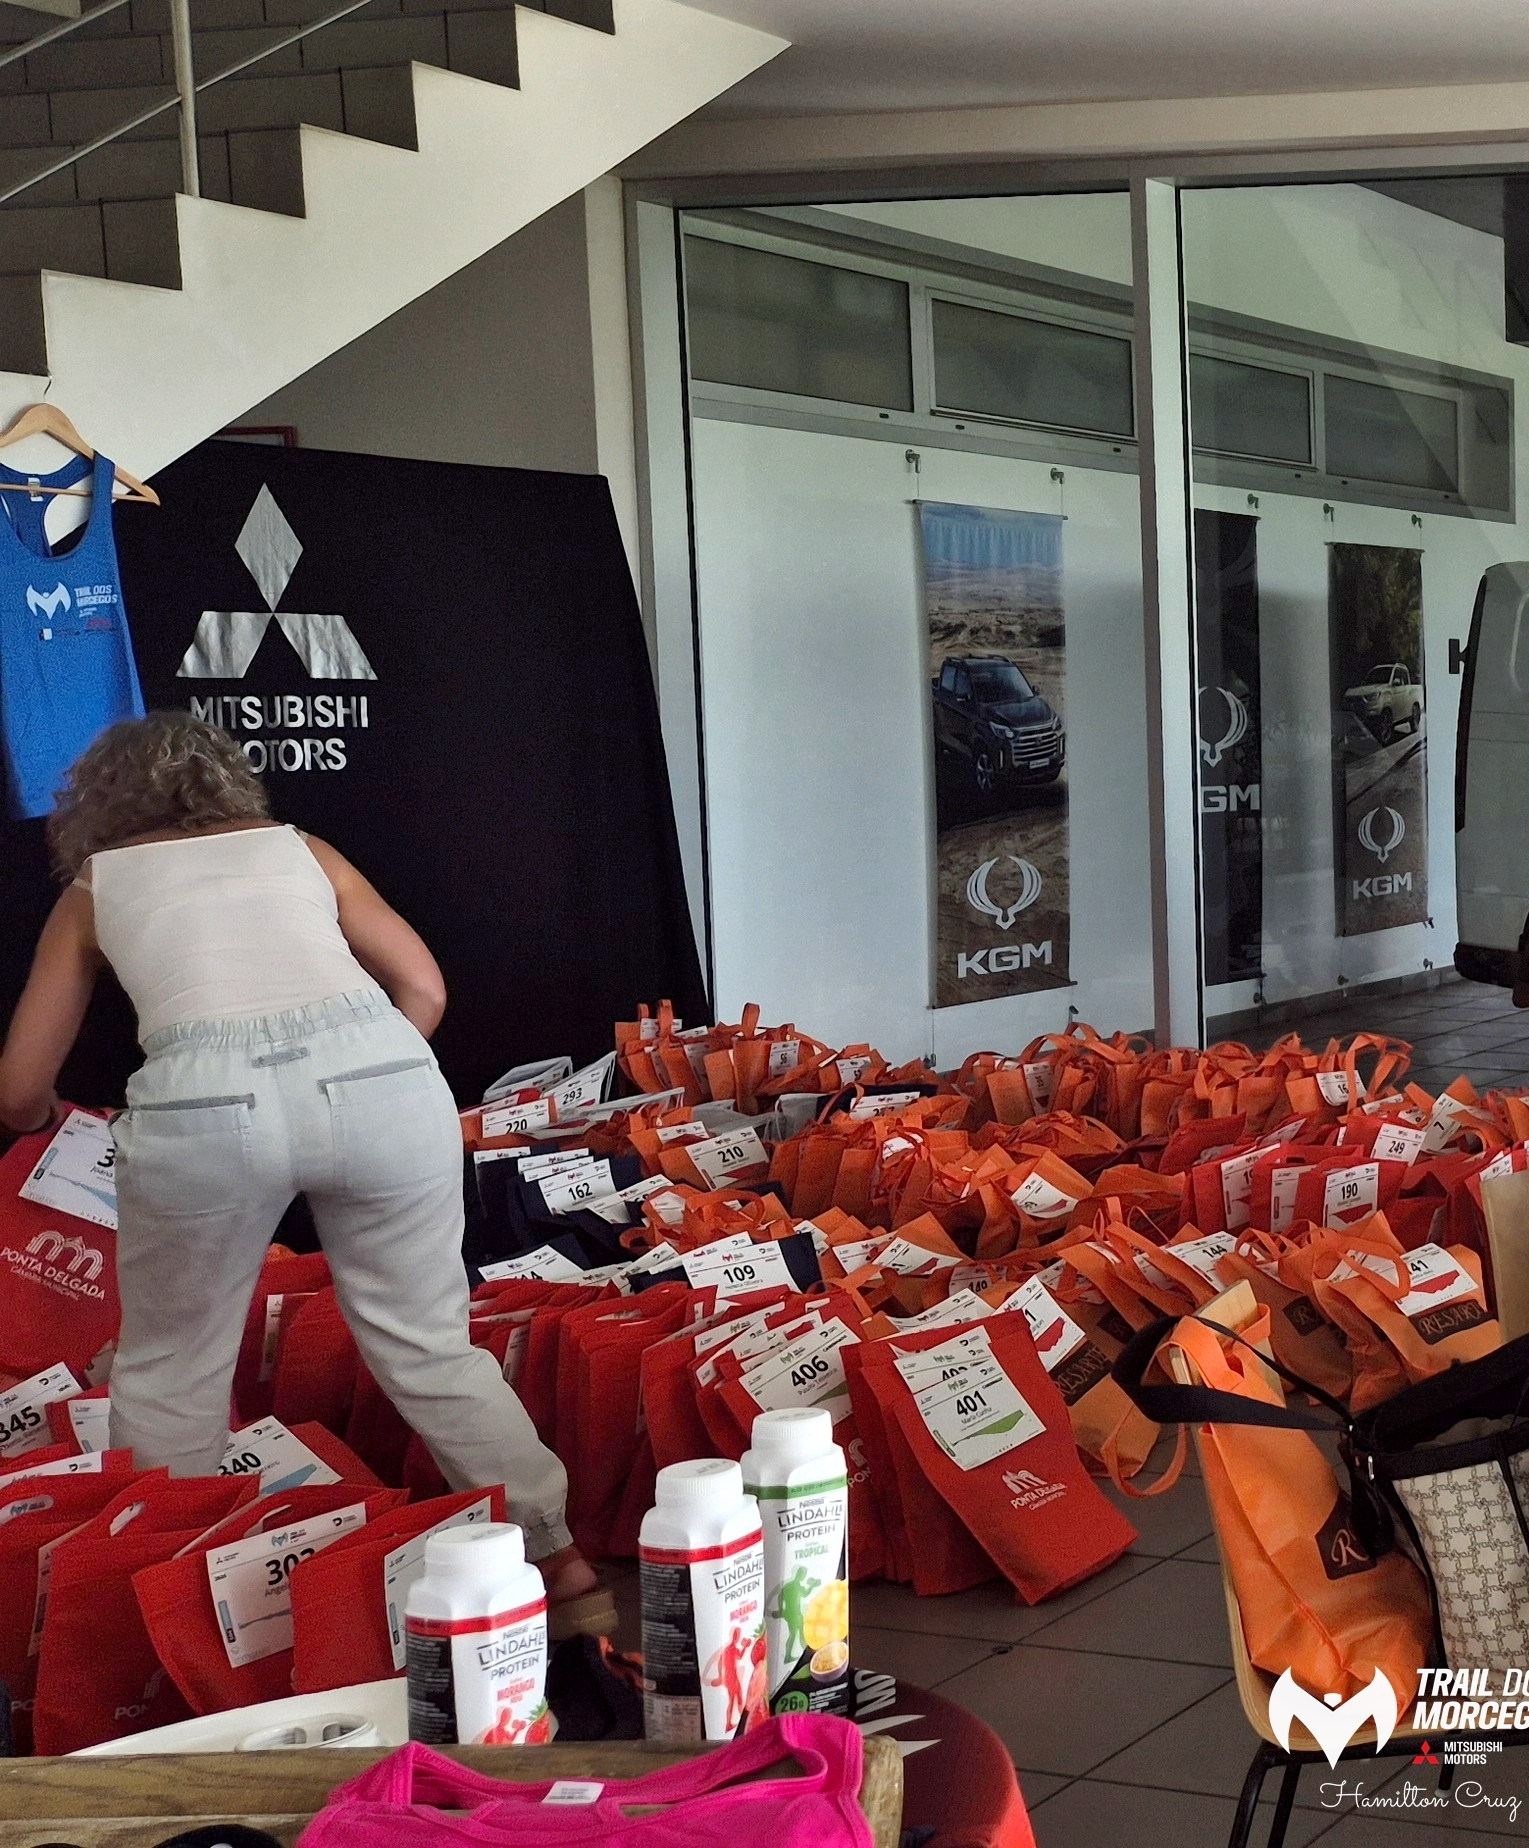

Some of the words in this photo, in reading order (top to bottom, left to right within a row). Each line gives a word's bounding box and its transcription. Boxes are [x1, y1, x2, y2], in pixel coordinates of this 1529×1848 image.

[189, 695, 369, 730] MITSUBISHI
[242, 737, 348, 774] OTORS
[1200, 783, 1260, 813] GM
[1353, 871, 1413, 900] KGM
[957, 940, 1053, 979] KGM
[562, 1087, 583, 1105] 293
[717, 1146, 744, 1163] 210
[1388, 1140, 1406, 1155] 249
[567, 1182, 593, 1200] 162
[1341, 1182, 1358, 1200] 190
[0, 1248, 43, 1273] PONTA
[44, 1266, 106, 1300] DELGADA
[723, 1264, 756, 1284] 109
[1408, 1259, 1429, 1274] 41
[790, 1355, 829, 1387] 406
[956, 1390, 988, 1416] 401
[787, 1524, 836, 1541] PROTEIN
[795, 1544, 829, 1560] TROPICAL
[725, 1578, 760, 1603] PROTEIN
[490, 1654, 539, 1680] PROTEIN
